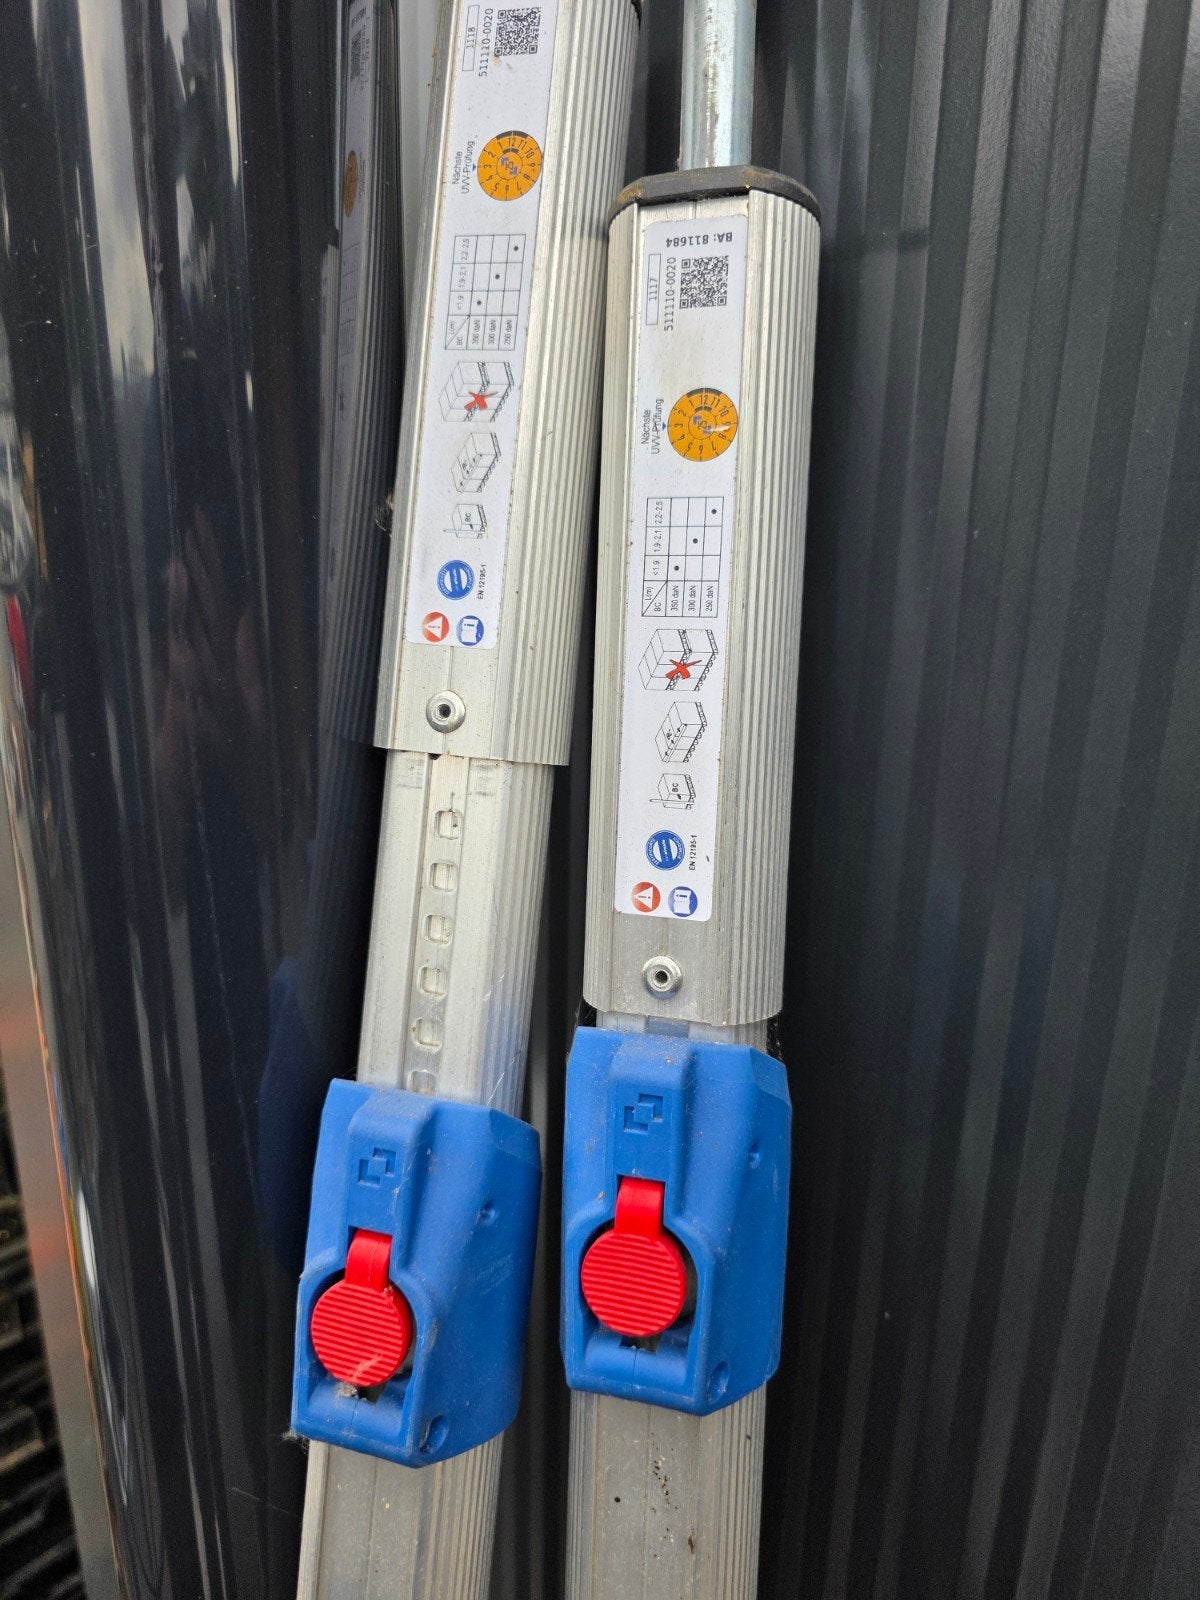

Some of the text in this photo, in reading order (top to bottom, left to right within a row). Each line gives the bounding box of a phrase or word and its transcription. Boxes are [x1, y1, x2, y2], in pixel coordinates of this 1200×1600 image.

[466, 26, 476, 49] 1118
[479, 8, 494, 77] 511110-0020
[507, 137, 516, 147] 12
[518, 140, 527, 150] 11
[524, 147, 535, 159] 10
[452, 151, 463, 185] Nächste
[461, 140, 476, 194] UVV-Prüfung
[485, 174, 494, 182] 4
[522, 173, 531, 181] 8
[493, 182, 500, 192] 5
[516, 182, 522, 191] 7
[665, 231, 733, 248] BA: 811684
[648, 277, 658, 301] 1117
[664, 257, 677, 331] 511110-0020
[699, 394, 709, 405] 12
[710, 396, 721, 408] 11
[718, 405, 729, 417] 10
[641, 409, 651, 445] Nächste
[697, 420, 708, 430] 25
[686, 441, 693, 451] 5
[698, 444, 704, 455] 6
[711, 441, 717, 451] 7
[464, 512, 472, 522] BC
[477, 564, 487, 600] EN 12195-1
[645, 586, 654, 601] L(m)
[670, 585, 679, 612] 350 daN
[688, 585, 697, 612] 300 daN
[705, 585, 714, 612] 250 daN
[653, 602, 662, 612] BC
[671, 782, 679, 793] BC
[688, 834, 698, 871] EN 12195-1
